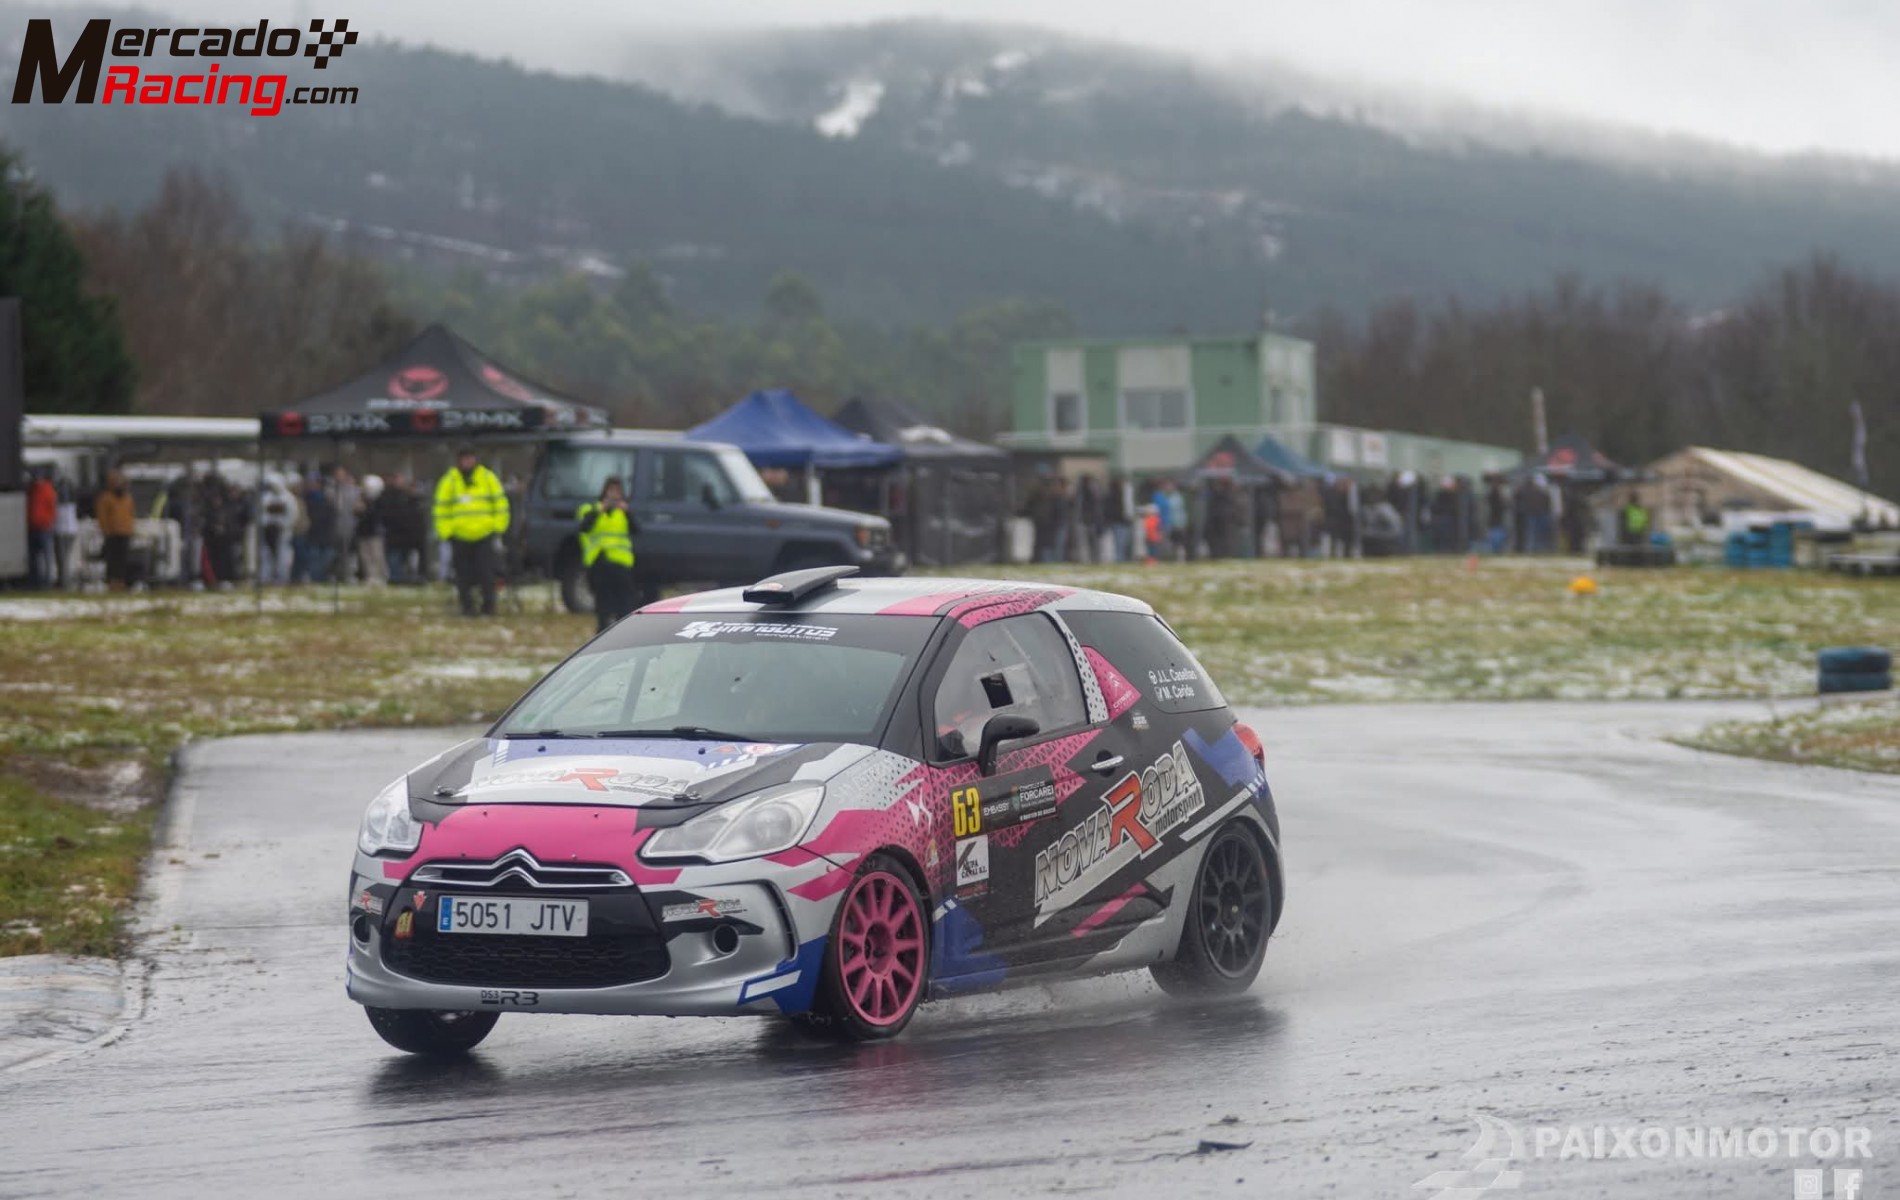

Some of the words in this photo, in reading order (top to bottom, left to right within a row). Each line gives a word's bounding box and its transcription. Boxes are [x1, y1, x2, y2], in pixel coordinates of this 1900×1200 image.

[1019, 784, 1054, 802] FORCAREI
[952, 786, 981, 837] 63
[1155, 790, 1201, 837] motorsport
[456, 901, 511, 930] 5051
[530, 903, 576, 931] JTV
[481, 990, 499, 999] DS3
[500, 990, 539, 1006] R3
